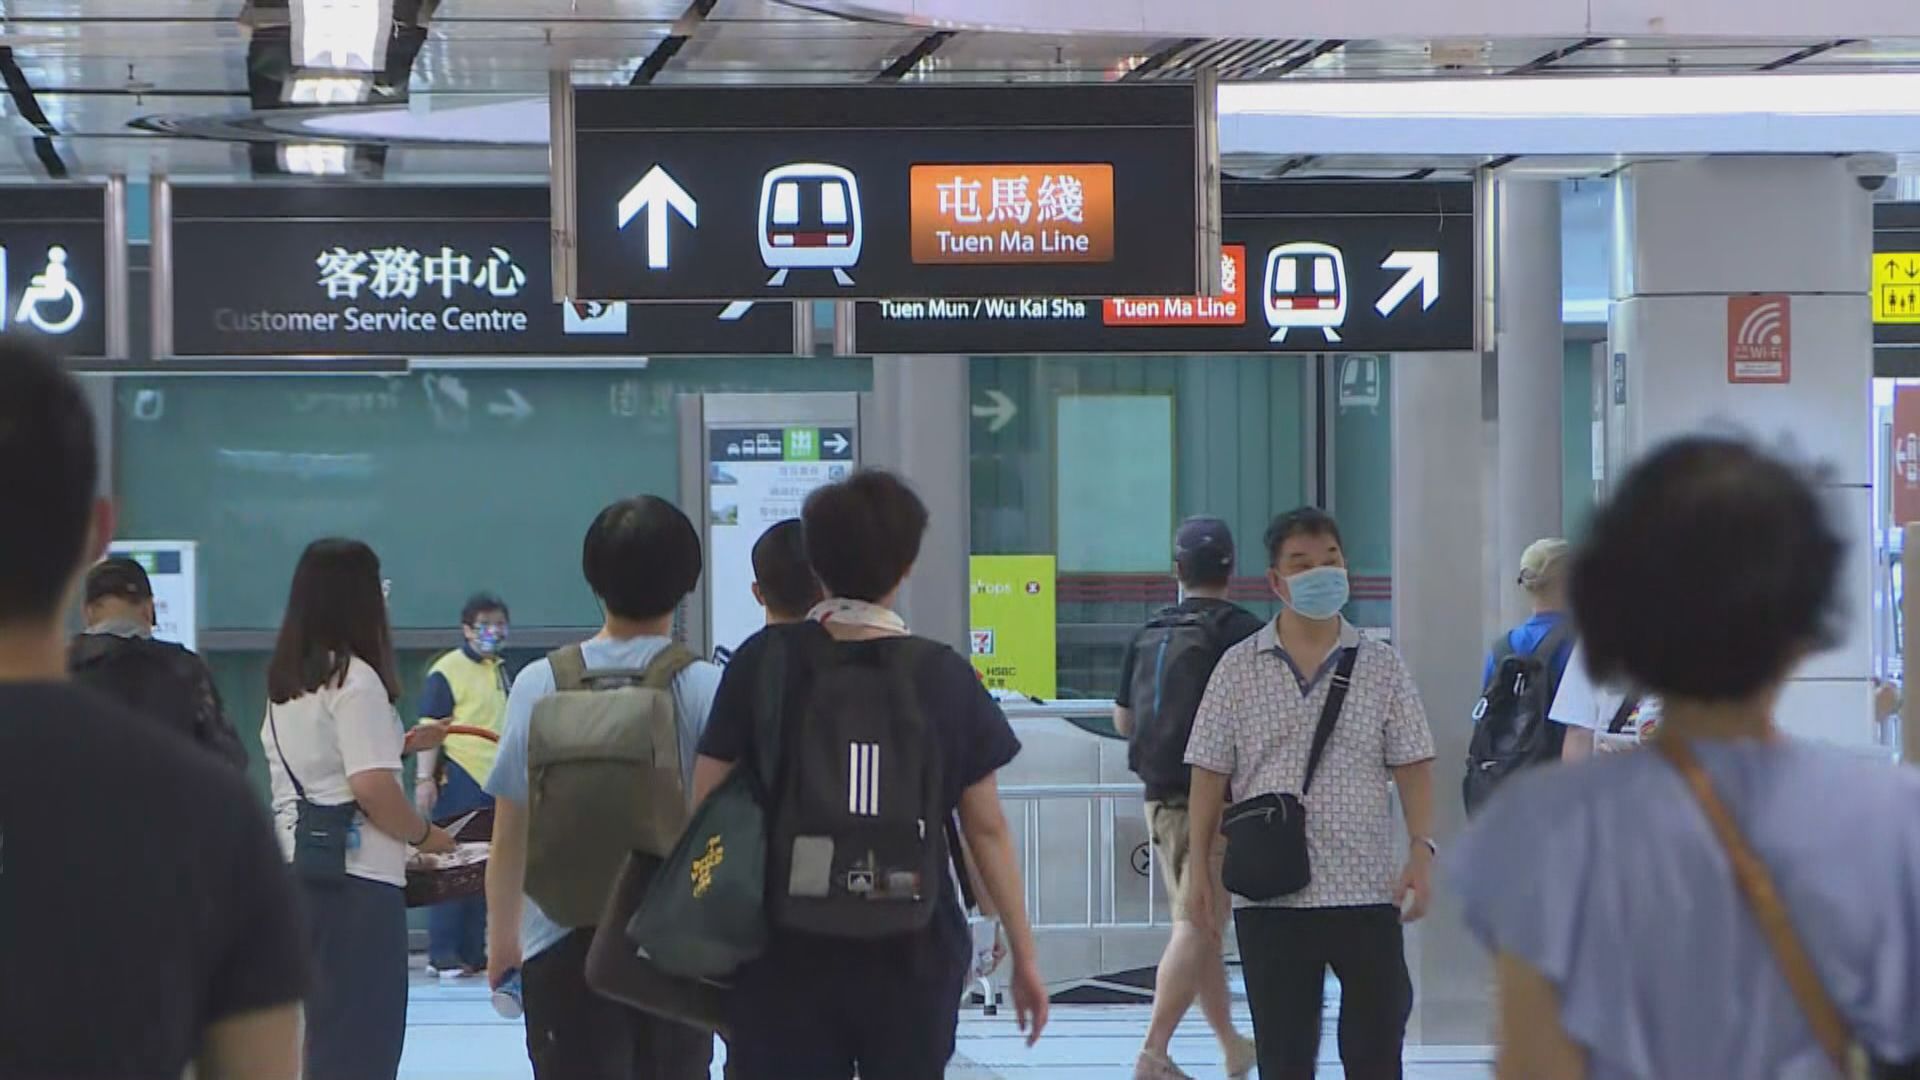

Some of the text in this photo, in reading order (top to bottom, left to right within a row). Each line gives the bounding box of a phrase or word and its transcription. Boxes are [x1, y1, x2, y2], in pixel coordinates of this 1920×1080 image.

[936, 175, 1084, 224] 屯馬綫
[936, 230, 1089, 253] Tuen Ma Line
[315, 247, 526, 299] 客務中心
[214, 306, 527, 332] Customer Service Centre
[879, 300, 924, 319] Tuen
[928, 300, 969, 319] Mun
[986, 300, 1015, 319] Wu
[1052, 300, 1086, 319] Sha
[1113, 298, 1236, 318] Tuen Ma Line
[987, 667, 1017, 677] HSBC
